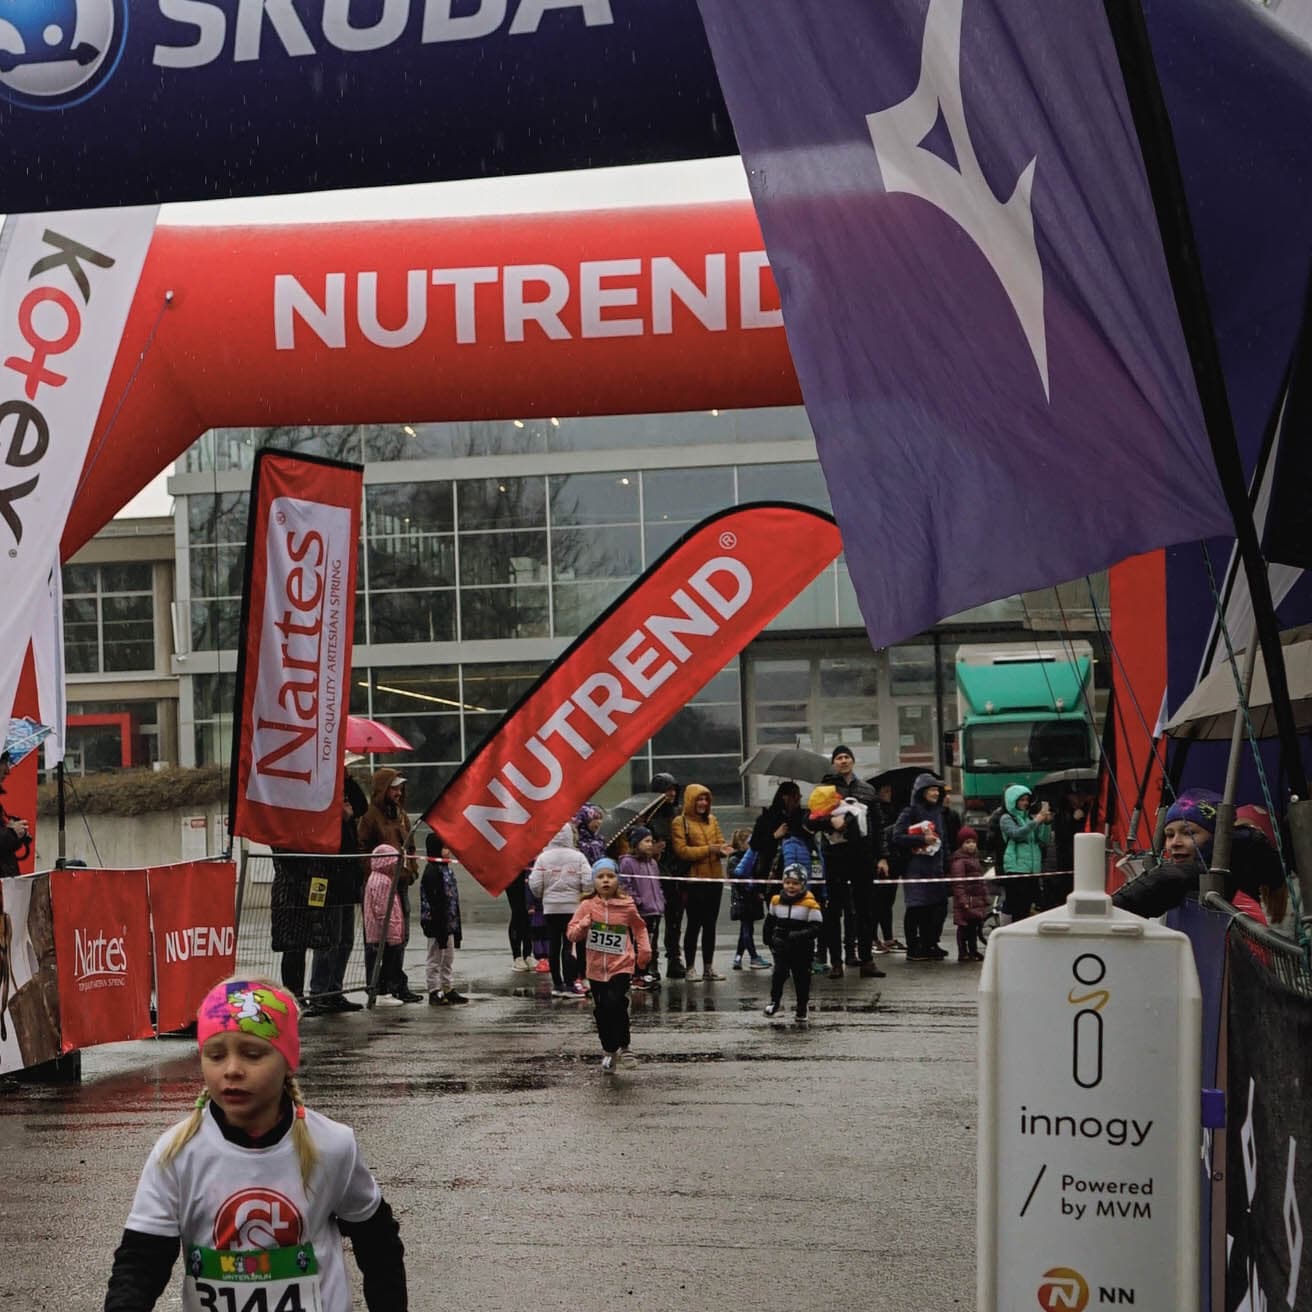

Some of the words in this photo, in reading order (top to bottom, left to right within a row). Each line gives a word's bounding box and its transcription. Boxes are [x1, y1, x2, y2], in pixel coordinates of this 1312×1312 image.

[330, 558, 343, 606] SPRING
[256, 529, 324, 785] Nartes
[326, 609, 340, 673] ARTESIAN
[324, 676, 337, 734] QUALITY
[462, 555, 753, 851] NUTREND
[321, 737, 332, 762] TOP
[73, 927, 127, 976] Nartes
[165, 926, 235, 964] NUTEND
[590, 930, 622, 948] 3152
[1020, 1105, 1154, 1147] innogy
[1062, 1174, 1154, 1195] Powered
[1062, 1197, 1087, 1220] by
[1096, 1201, 1152, 1220] MVM
[1098, 1286, 1135, 1305] NN
